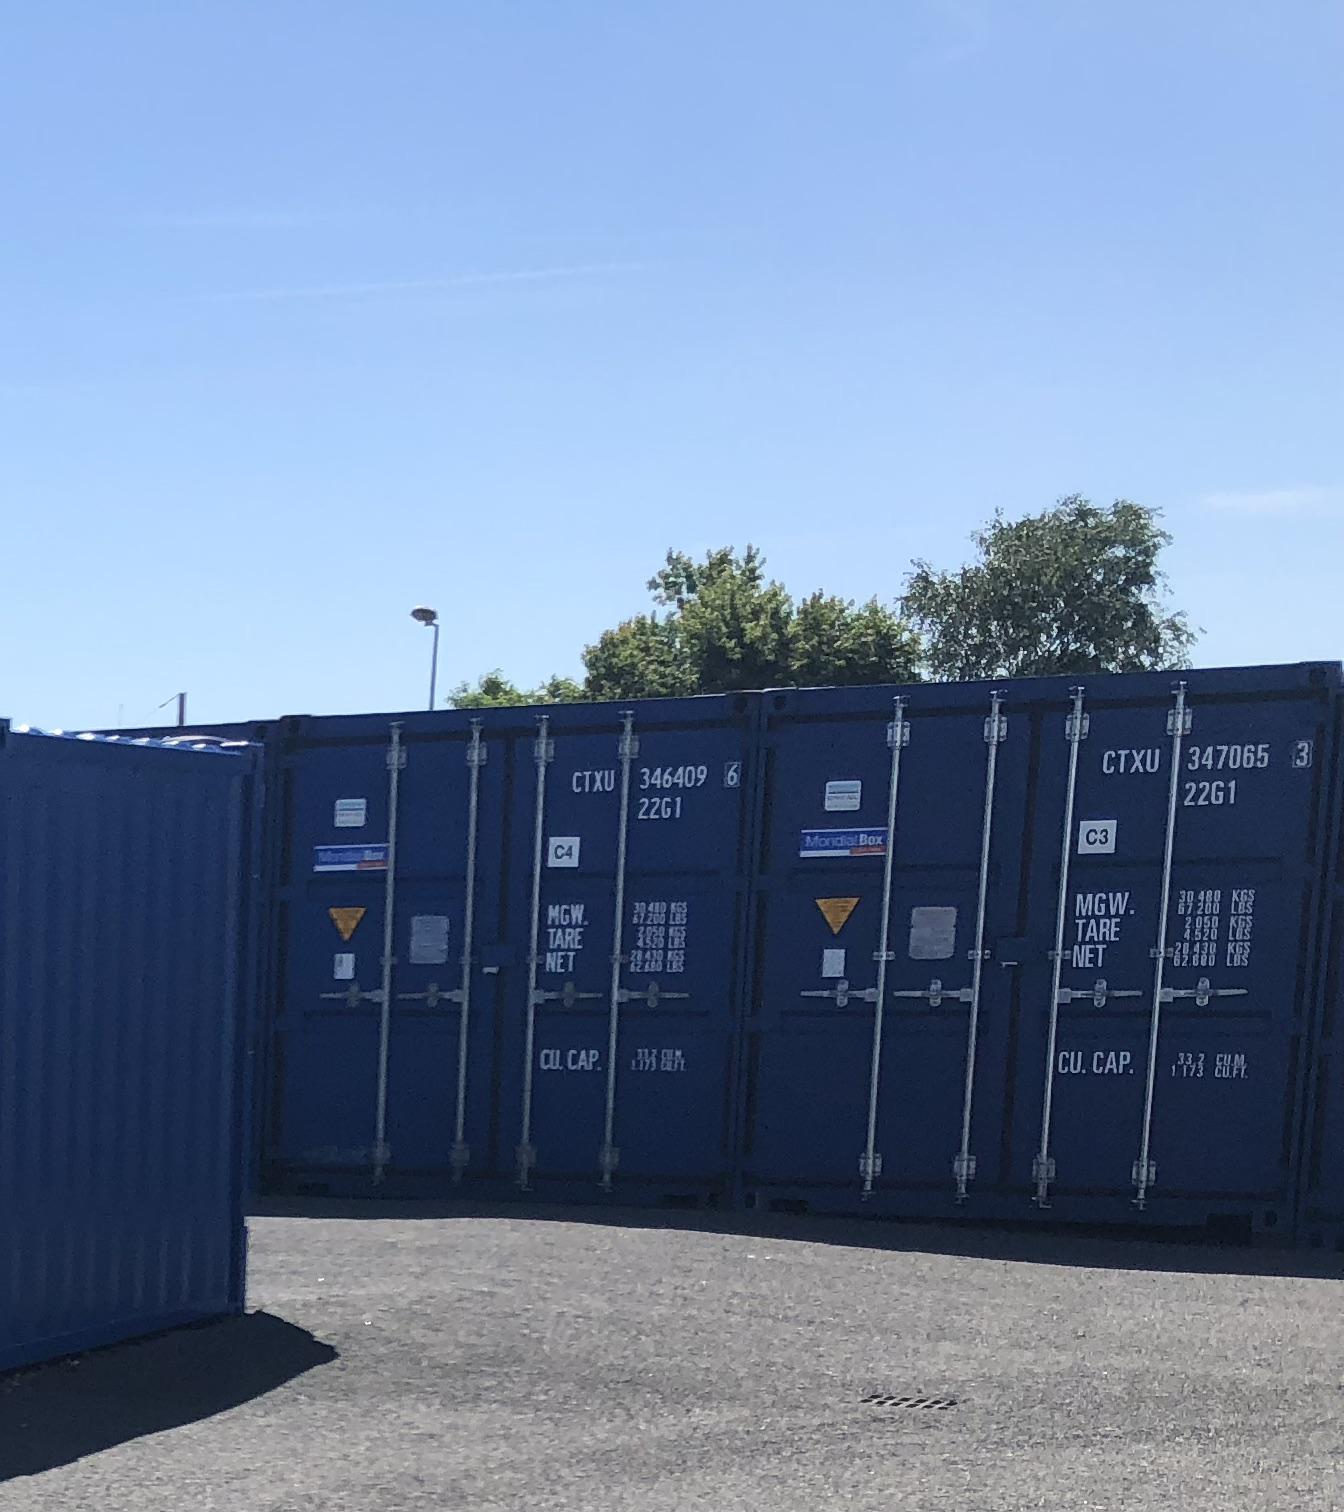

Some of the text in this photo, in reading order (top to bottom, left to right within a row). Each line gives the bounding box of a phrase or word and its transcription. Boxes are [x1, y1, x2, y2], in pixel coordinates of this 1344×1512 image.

[1102, 742, 1309, 774] CTXU 347065 3
[572, 764, 739, 793] CTXU 346409 6
[1184, 779, 1236, 806] 22G1
[637, 797, 682, 819] 22G1
[1085, 829, 1109, 845] C3
[554, 844, 573, 859] C4
[547, 903, 589, 926] MGW.
[1075, 892, 1135, 917] MGW.
[547, 928, 584, 949] TARE
[1075, 918, 1120, 942] TARE
[546, 951, 576, 972] NET
[1072, 944, 1107, 968] NET
